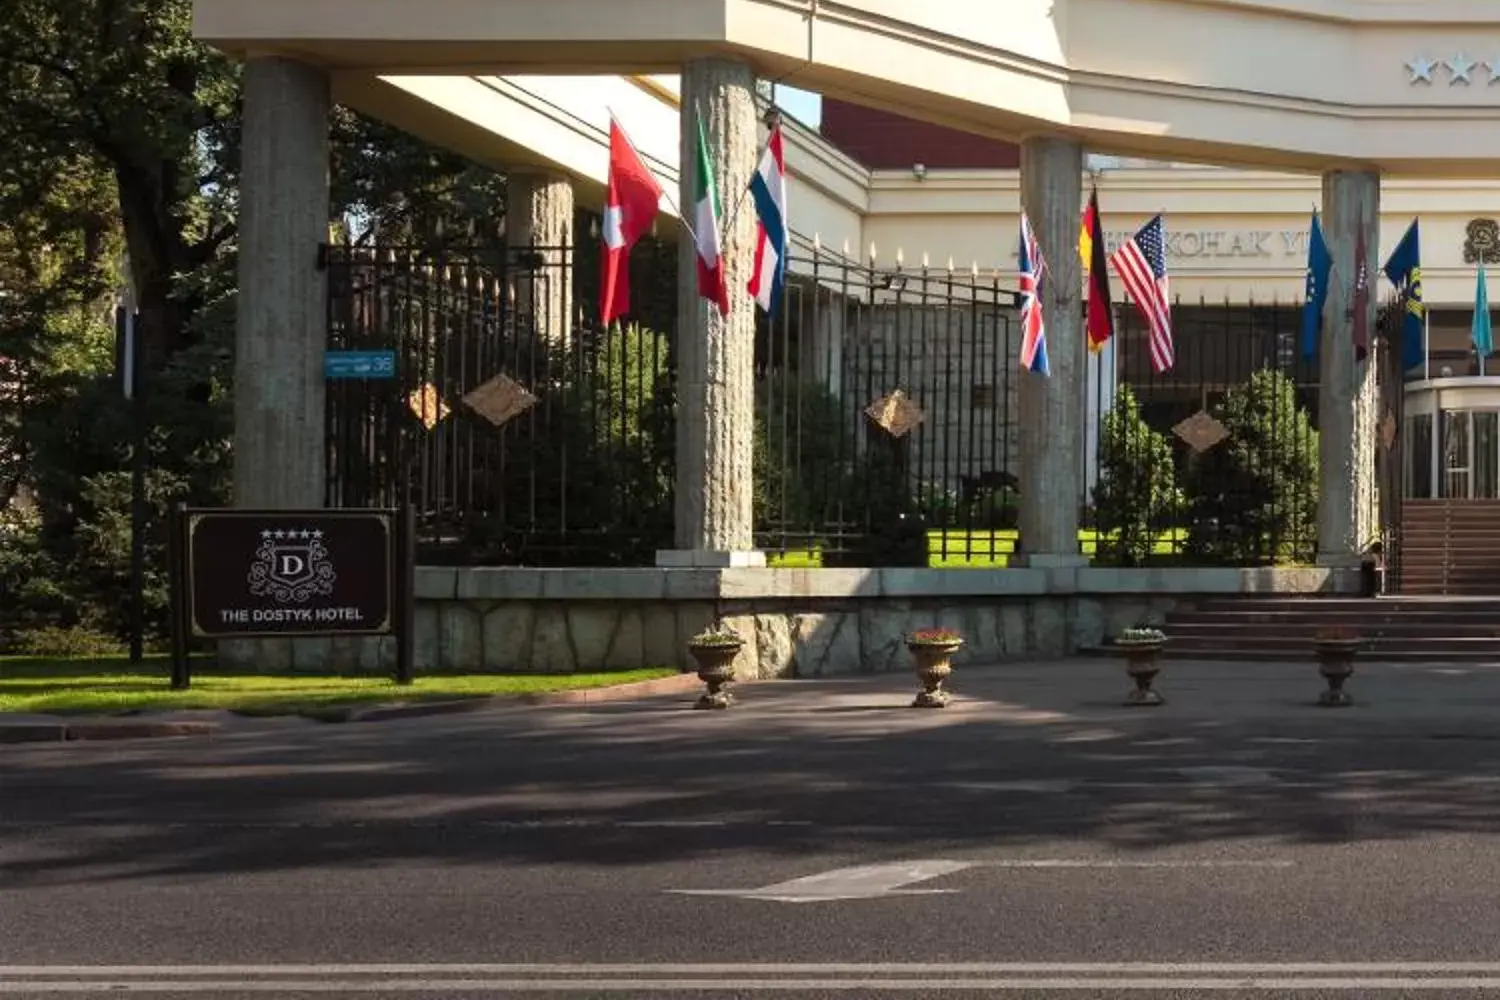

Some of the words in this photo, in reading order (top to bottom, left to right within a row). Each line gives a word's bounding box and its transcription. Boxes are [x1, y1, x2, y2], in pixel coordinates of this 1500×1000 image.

[280, 555, 303, 576] D
[221, 609, 249, 623] THE
[253, 608, 313, 623] DOSTYK
[315, 608, 364, 622] HOTEL
